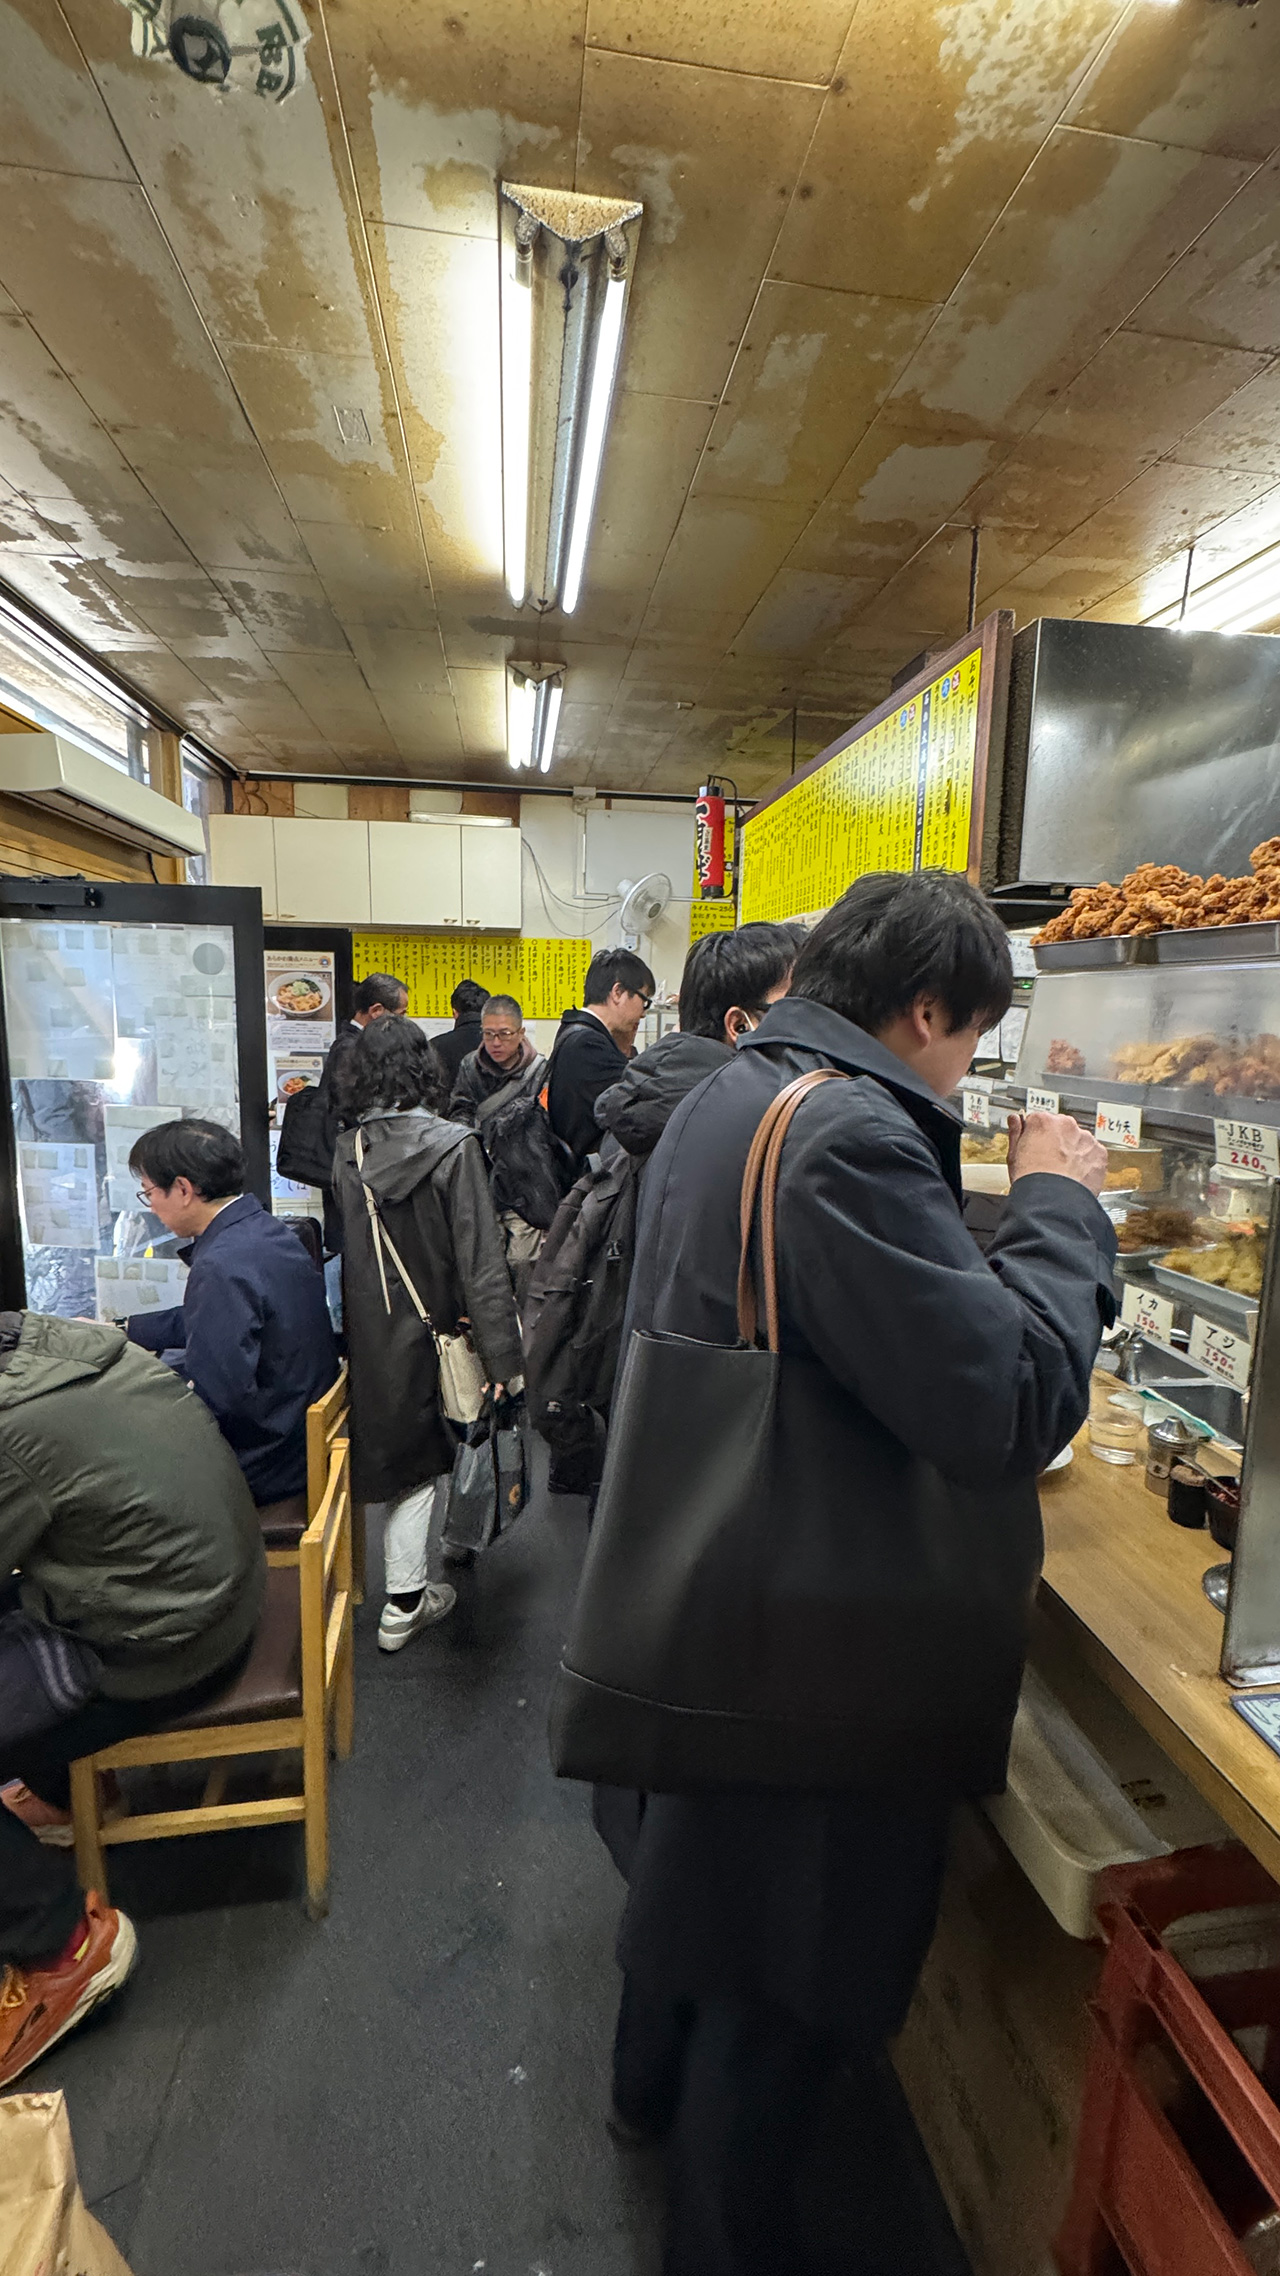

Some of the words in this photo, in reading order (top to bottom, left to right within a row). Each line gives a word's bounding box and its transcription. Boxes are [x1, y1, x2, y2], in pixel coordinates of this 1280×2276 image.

[1226, 1123, 1263, 1143] JKB
[1136, 1293, 1159, 1311] イカ
[1206, 1325, 1236, 1349] アジ
